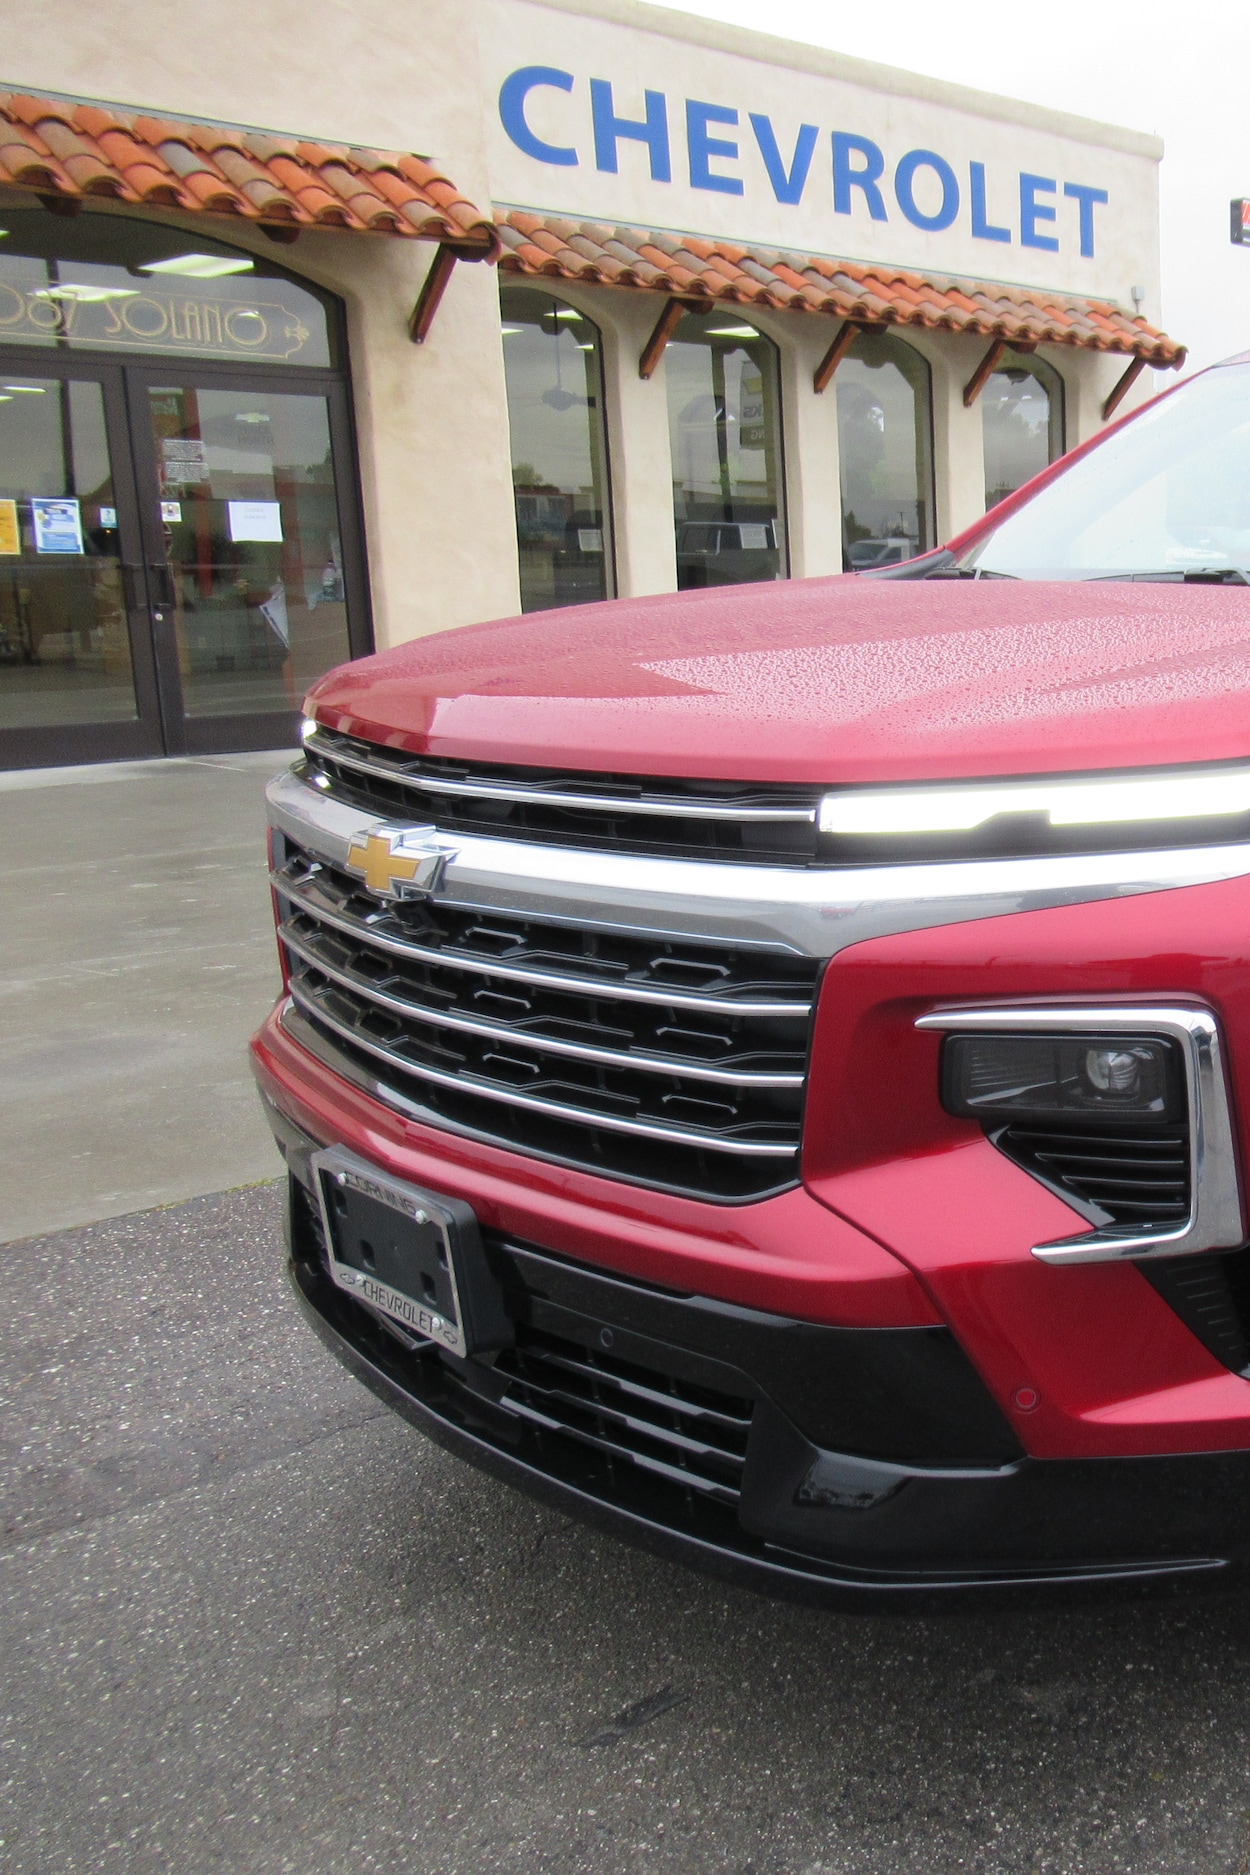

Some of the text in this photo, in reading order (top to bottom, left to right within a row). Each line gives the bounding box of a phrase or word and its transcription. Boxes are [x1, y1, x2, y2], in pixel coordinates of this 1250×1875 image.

[499, 65, 1109, 258] CHEVROLET
[104, 292, 268, 346] SOLANO
[363, 1280, 437, 1333] CHEVROLET
